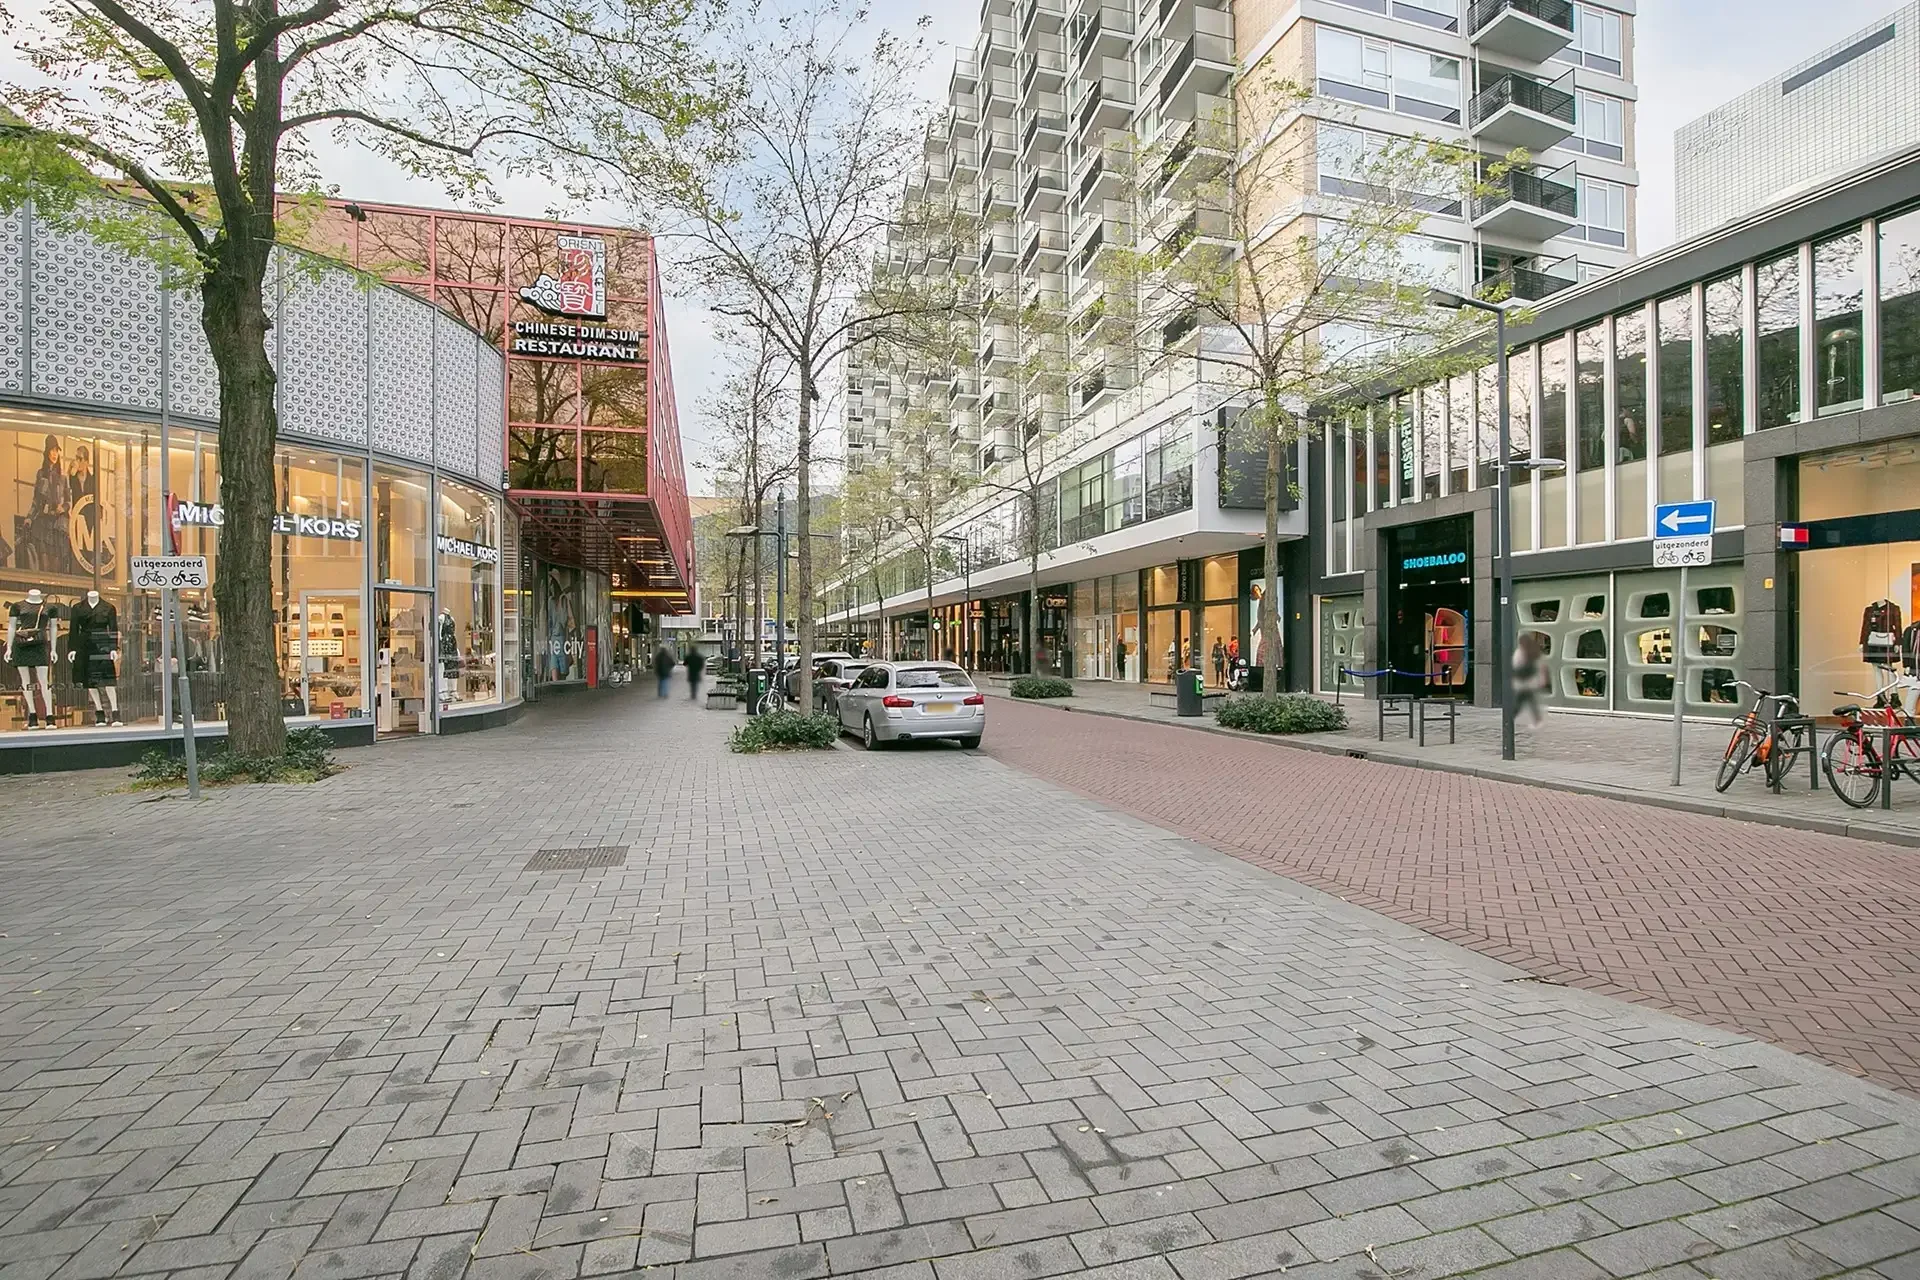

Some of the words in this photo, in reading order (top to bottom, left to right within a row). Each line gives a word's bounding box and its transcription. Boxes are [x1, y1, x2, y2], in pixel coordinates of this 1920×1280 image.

[560, 238, 604, 250] ORIENT
[515, 321, 576, 337] CHINESE
[581, 326, 606, 339] DIM
[611, 329, 639, 342] SUM
[515, 339, 638, 360] RESTAURANT
[300, 517, 361, 539] KORS
[437, 536, 475, 557] MICHAEL
[477, 545, 498, 561] KORS
[1655, 540, 1709, 550] uitgezonderd
[133, 559, 203, 570] uitgezonderd
[1403, 552, 1466, 569] SHOEBALOO
[563, 636, 584, 659] city
